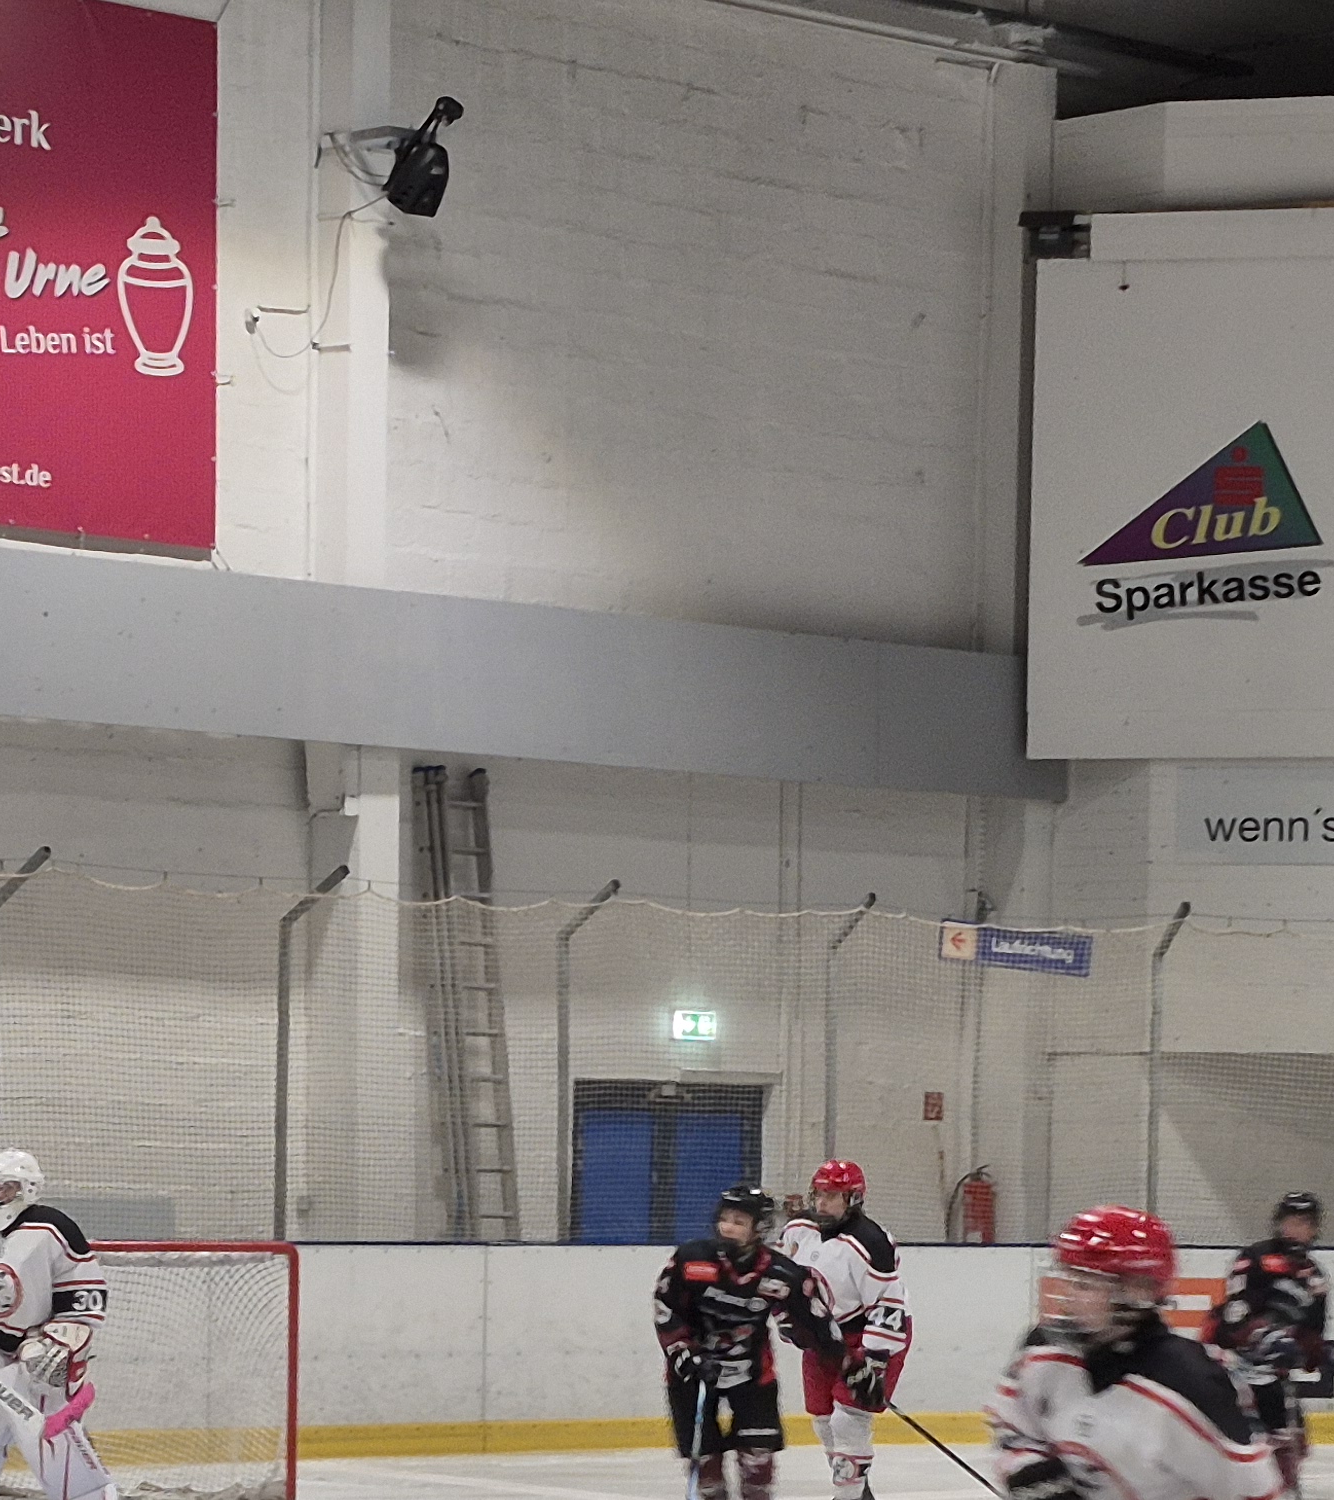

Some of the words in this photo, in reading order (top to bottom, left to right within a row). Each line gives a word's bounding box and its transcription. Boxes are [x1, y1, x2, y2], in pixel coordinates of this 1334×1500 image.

[4, 246, 111, 299] Urne
[82, 327, 116, 355] ist
[1150, 497, 1282, 551] Club
[1094, 568, 1322, 620] Sparkasse
[71, 1290, 103, 1311] 30
[867, 1306, 902, 1331] 44
